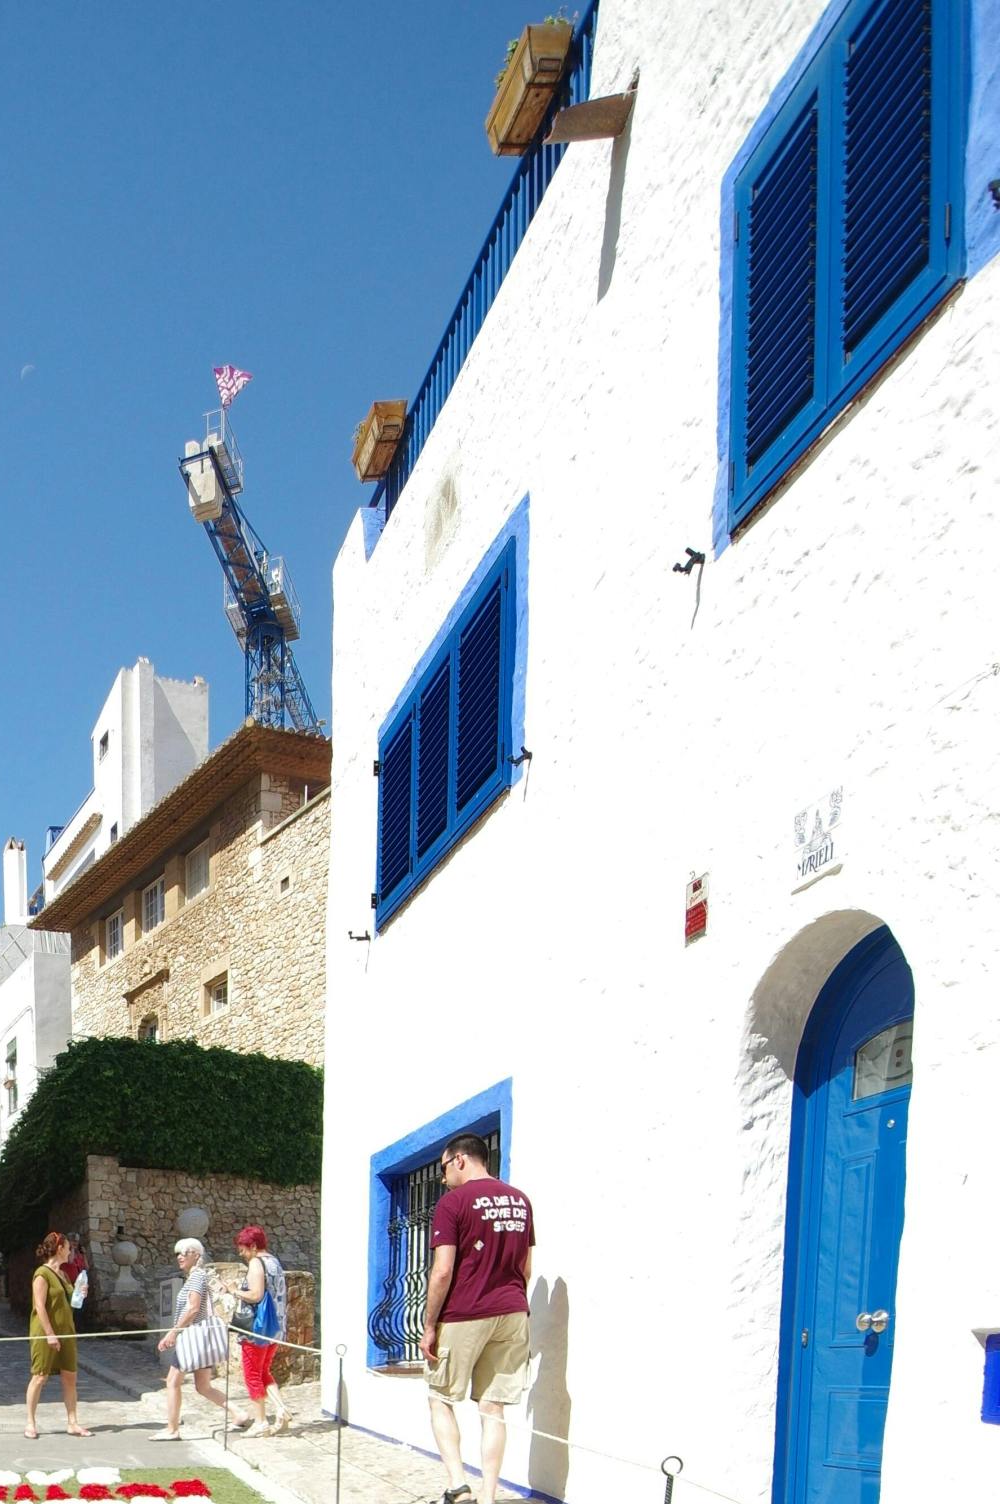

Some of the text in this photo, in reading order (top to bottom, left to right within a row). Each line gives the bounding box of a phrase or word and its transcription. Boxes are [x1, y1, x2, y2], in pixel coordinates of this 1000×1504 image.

[493, 1195, 509, 1207] DE
[510, 1195, 526, 1207] LA
[481, 1207, 527, 1220] JOVE DE
[493, 1220, 526, 1232] SITGES
